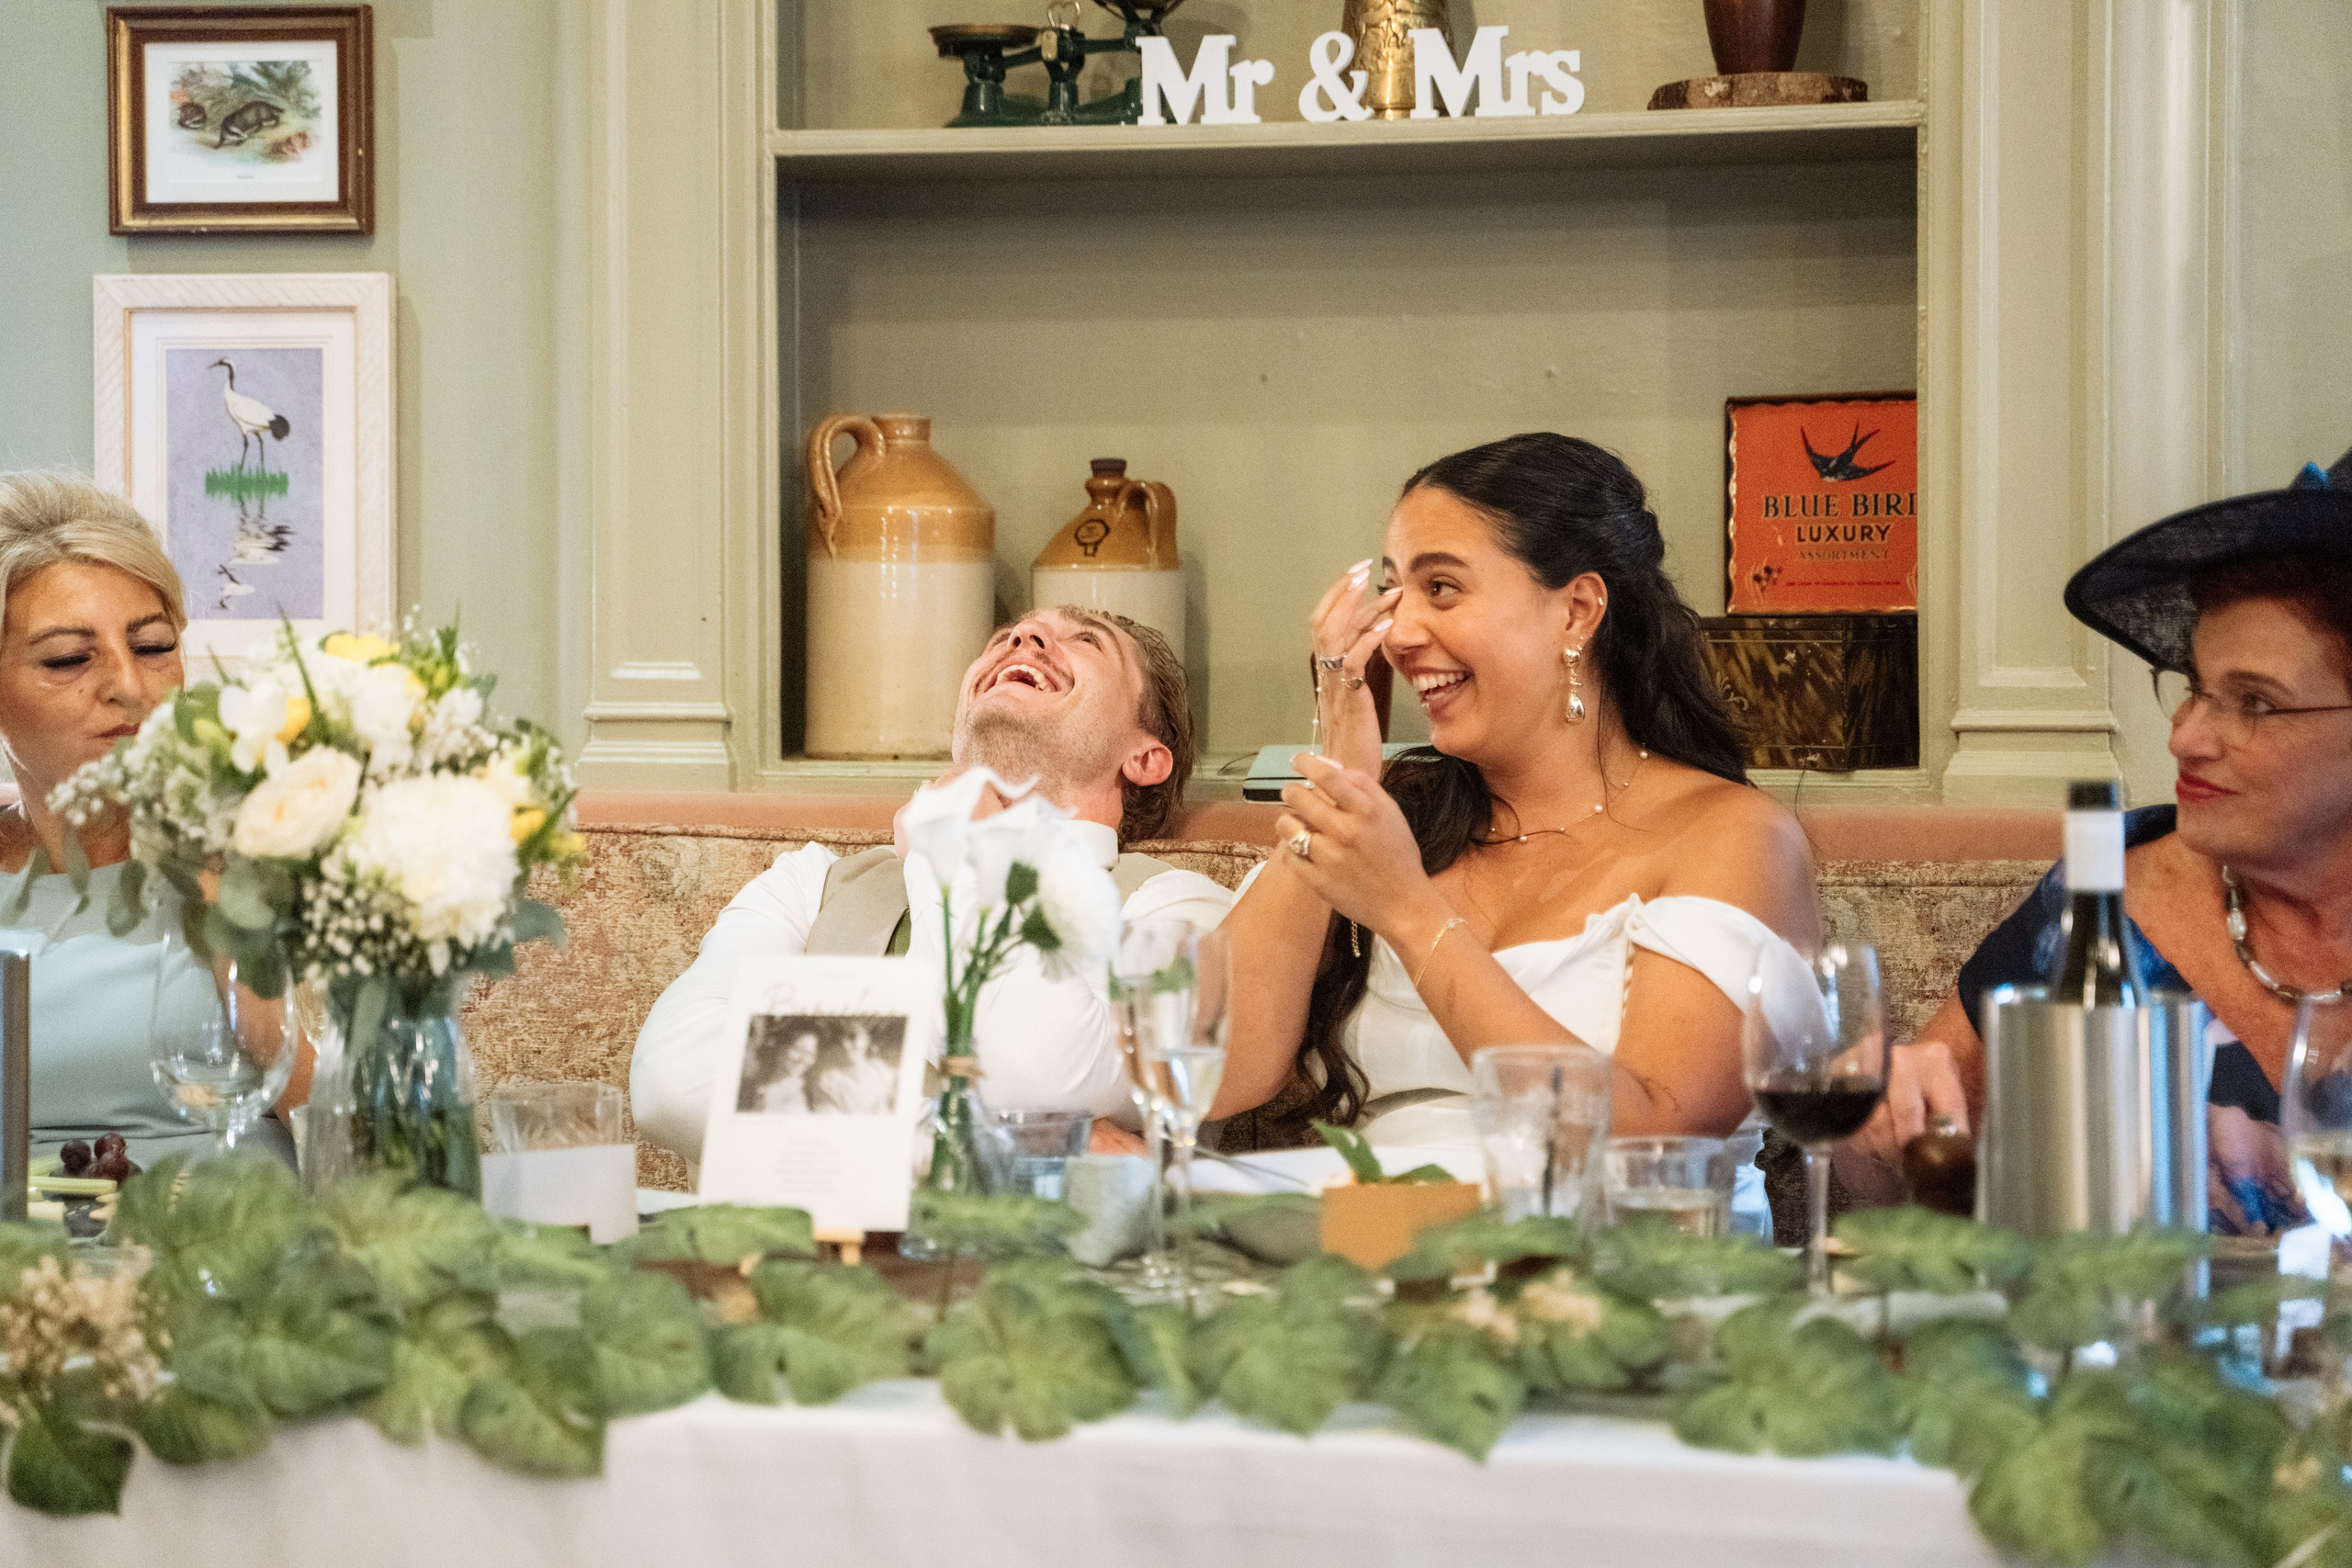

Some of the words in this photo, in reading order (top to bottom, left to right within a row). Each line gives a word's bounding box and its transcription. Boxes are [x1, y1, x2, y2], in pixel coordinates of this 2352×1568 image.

[1136, 34, 1274, 126] Mr
[1298, 30, 1375, 123] &
[1408, 25, 1586, 118] Mrs
[1764, 494, 1839, 517] BLUE
[1796, 525, 1891, 542] LUXURY
[1798, 549, 1889, 560] ASSORTMENT
